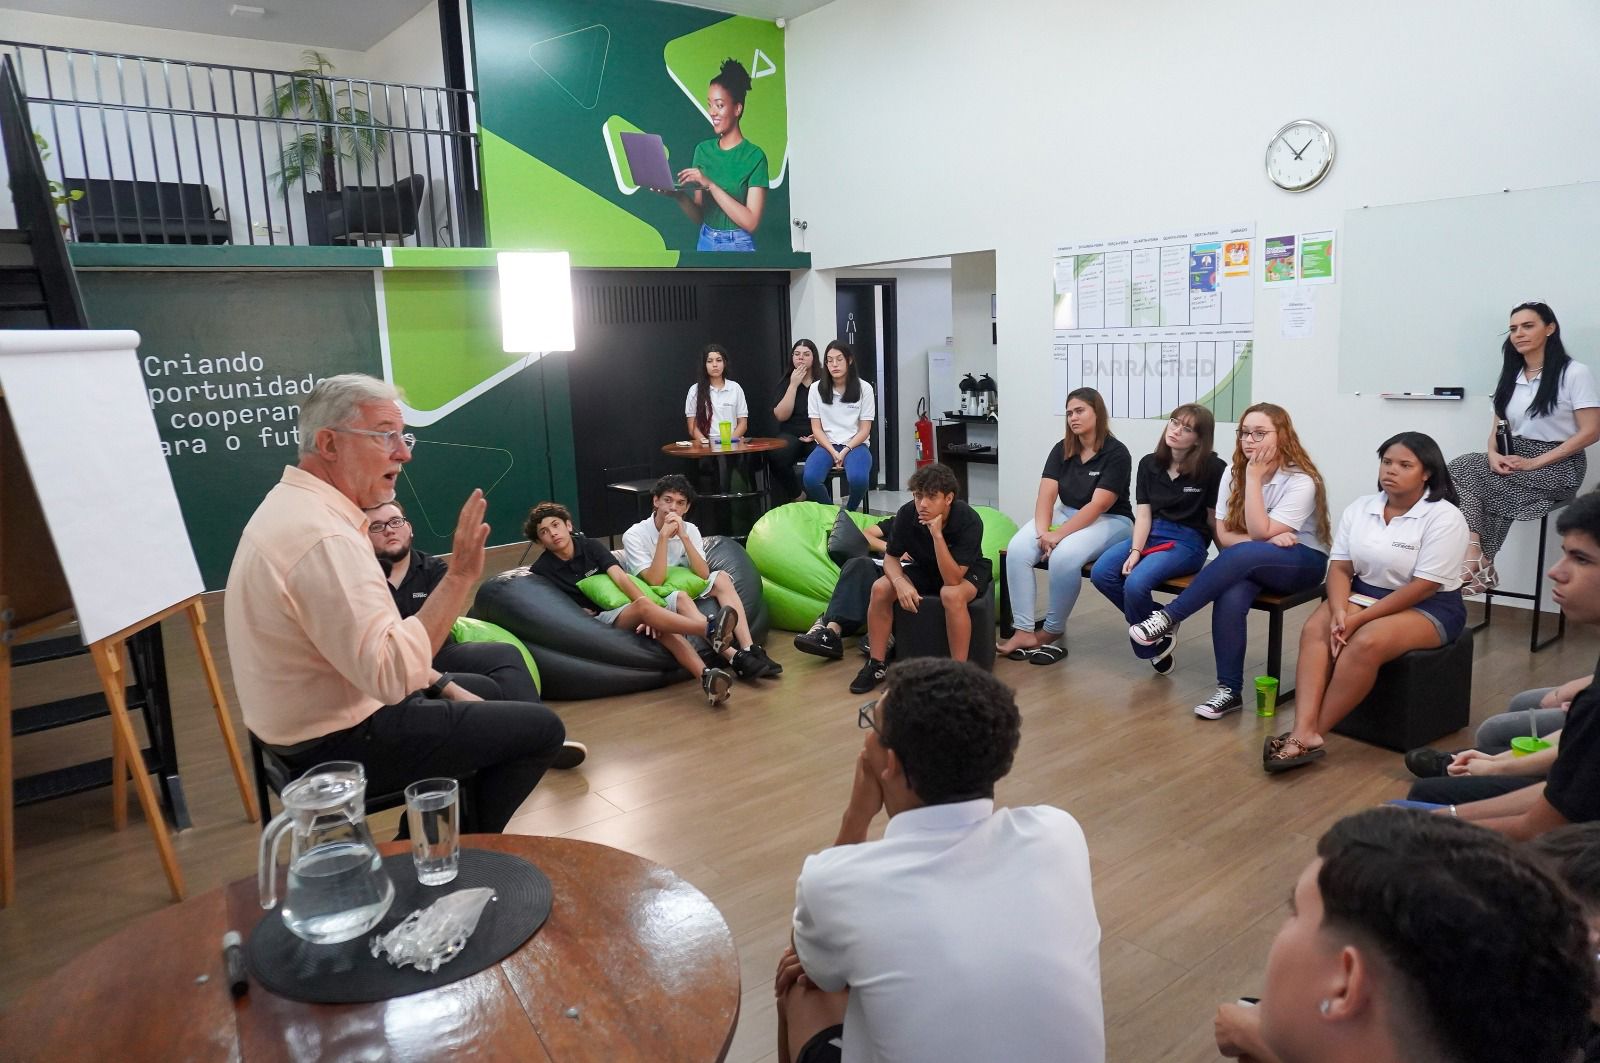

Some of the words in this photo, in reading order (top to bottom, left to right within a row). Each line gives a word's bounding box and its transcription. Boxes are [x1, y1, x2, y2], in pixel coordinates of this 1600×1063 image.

[144, 351, 264, 377] Criando
[1082, 358, 1215, 378] BARRACRED
[148, 373, 327, 409] portunidad
[170, 404, 301, 431] cooperan
[160, 437, 207, 457] ara
[226, 435, 241, 451] o
[258, 426, 301, 448] fut
